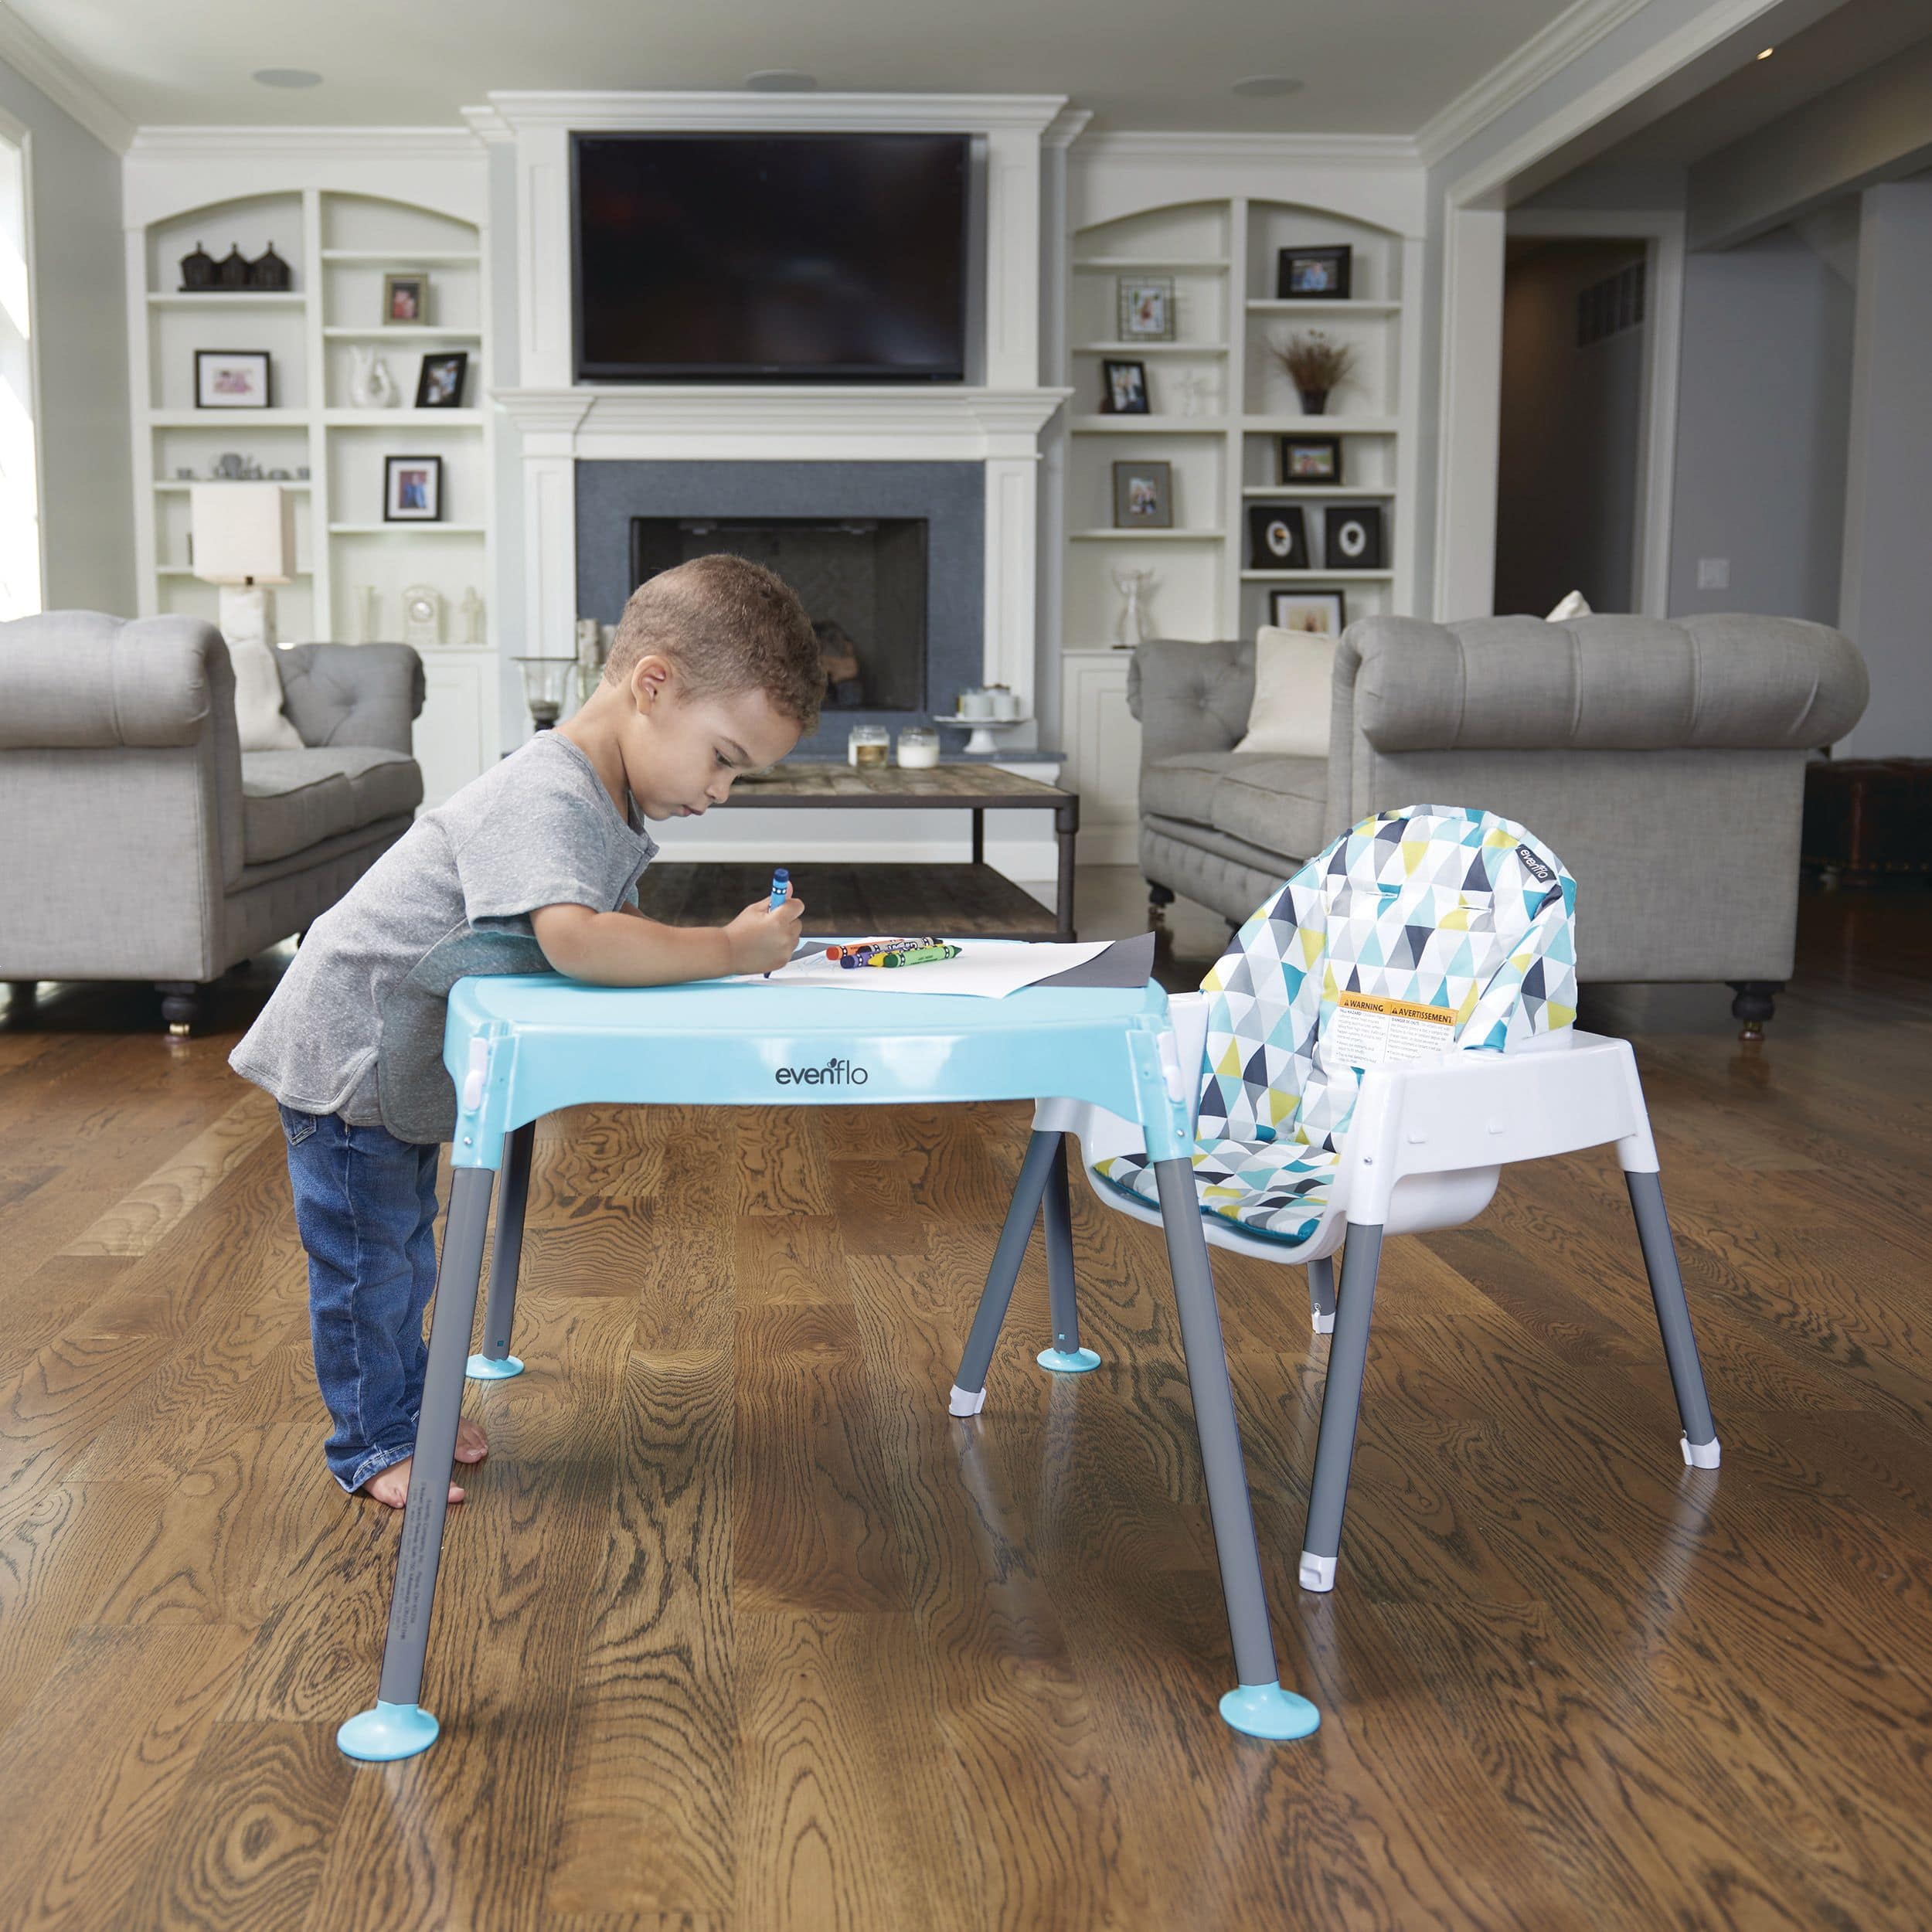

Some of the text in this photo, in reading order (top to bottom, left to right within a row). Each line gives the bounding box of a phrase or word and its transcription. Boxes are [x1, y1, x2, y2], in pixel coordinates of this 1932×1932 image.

[1520, 849, 1548, 879] evenflo
[1350, 1000, 1383, 1012] WARNING
[1398, 1009, 1453, 1024] AVERTISSEMENT
[775, 1058, 868, 1085] evenflo
